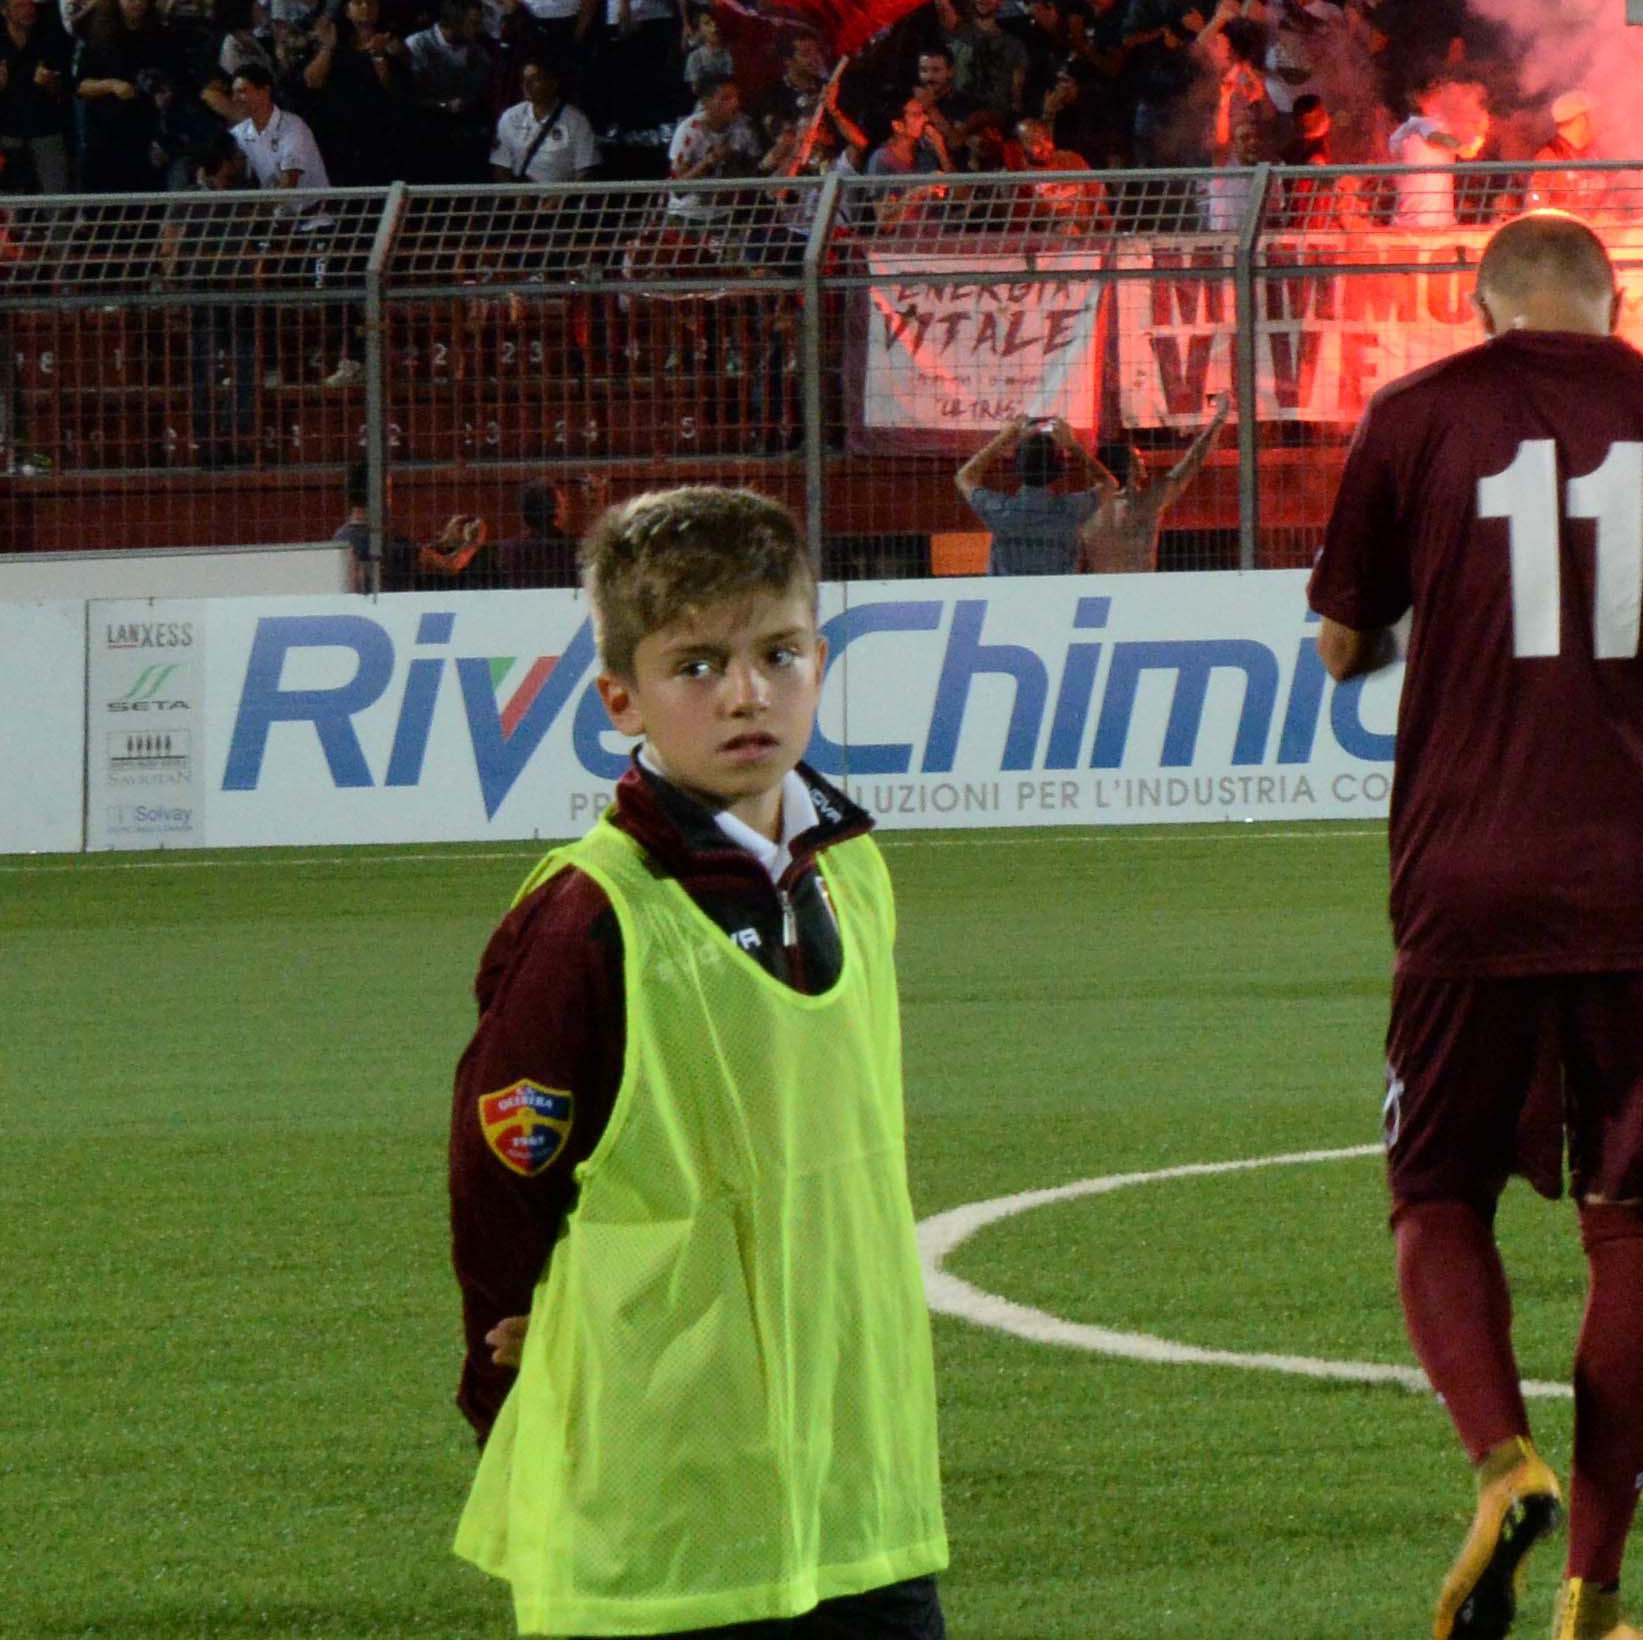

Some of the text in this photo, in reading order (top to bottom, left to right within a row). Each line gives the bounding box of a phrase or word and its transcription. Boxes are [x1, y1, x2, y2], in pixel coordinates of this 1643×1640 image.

[107, 622, 194, 648] LANXESS
[107, 700, 192, 712] SETA
[1018, 781, 1079, 811] PER
[1096, 775, 1315, 809] L'INDUSTRIA
